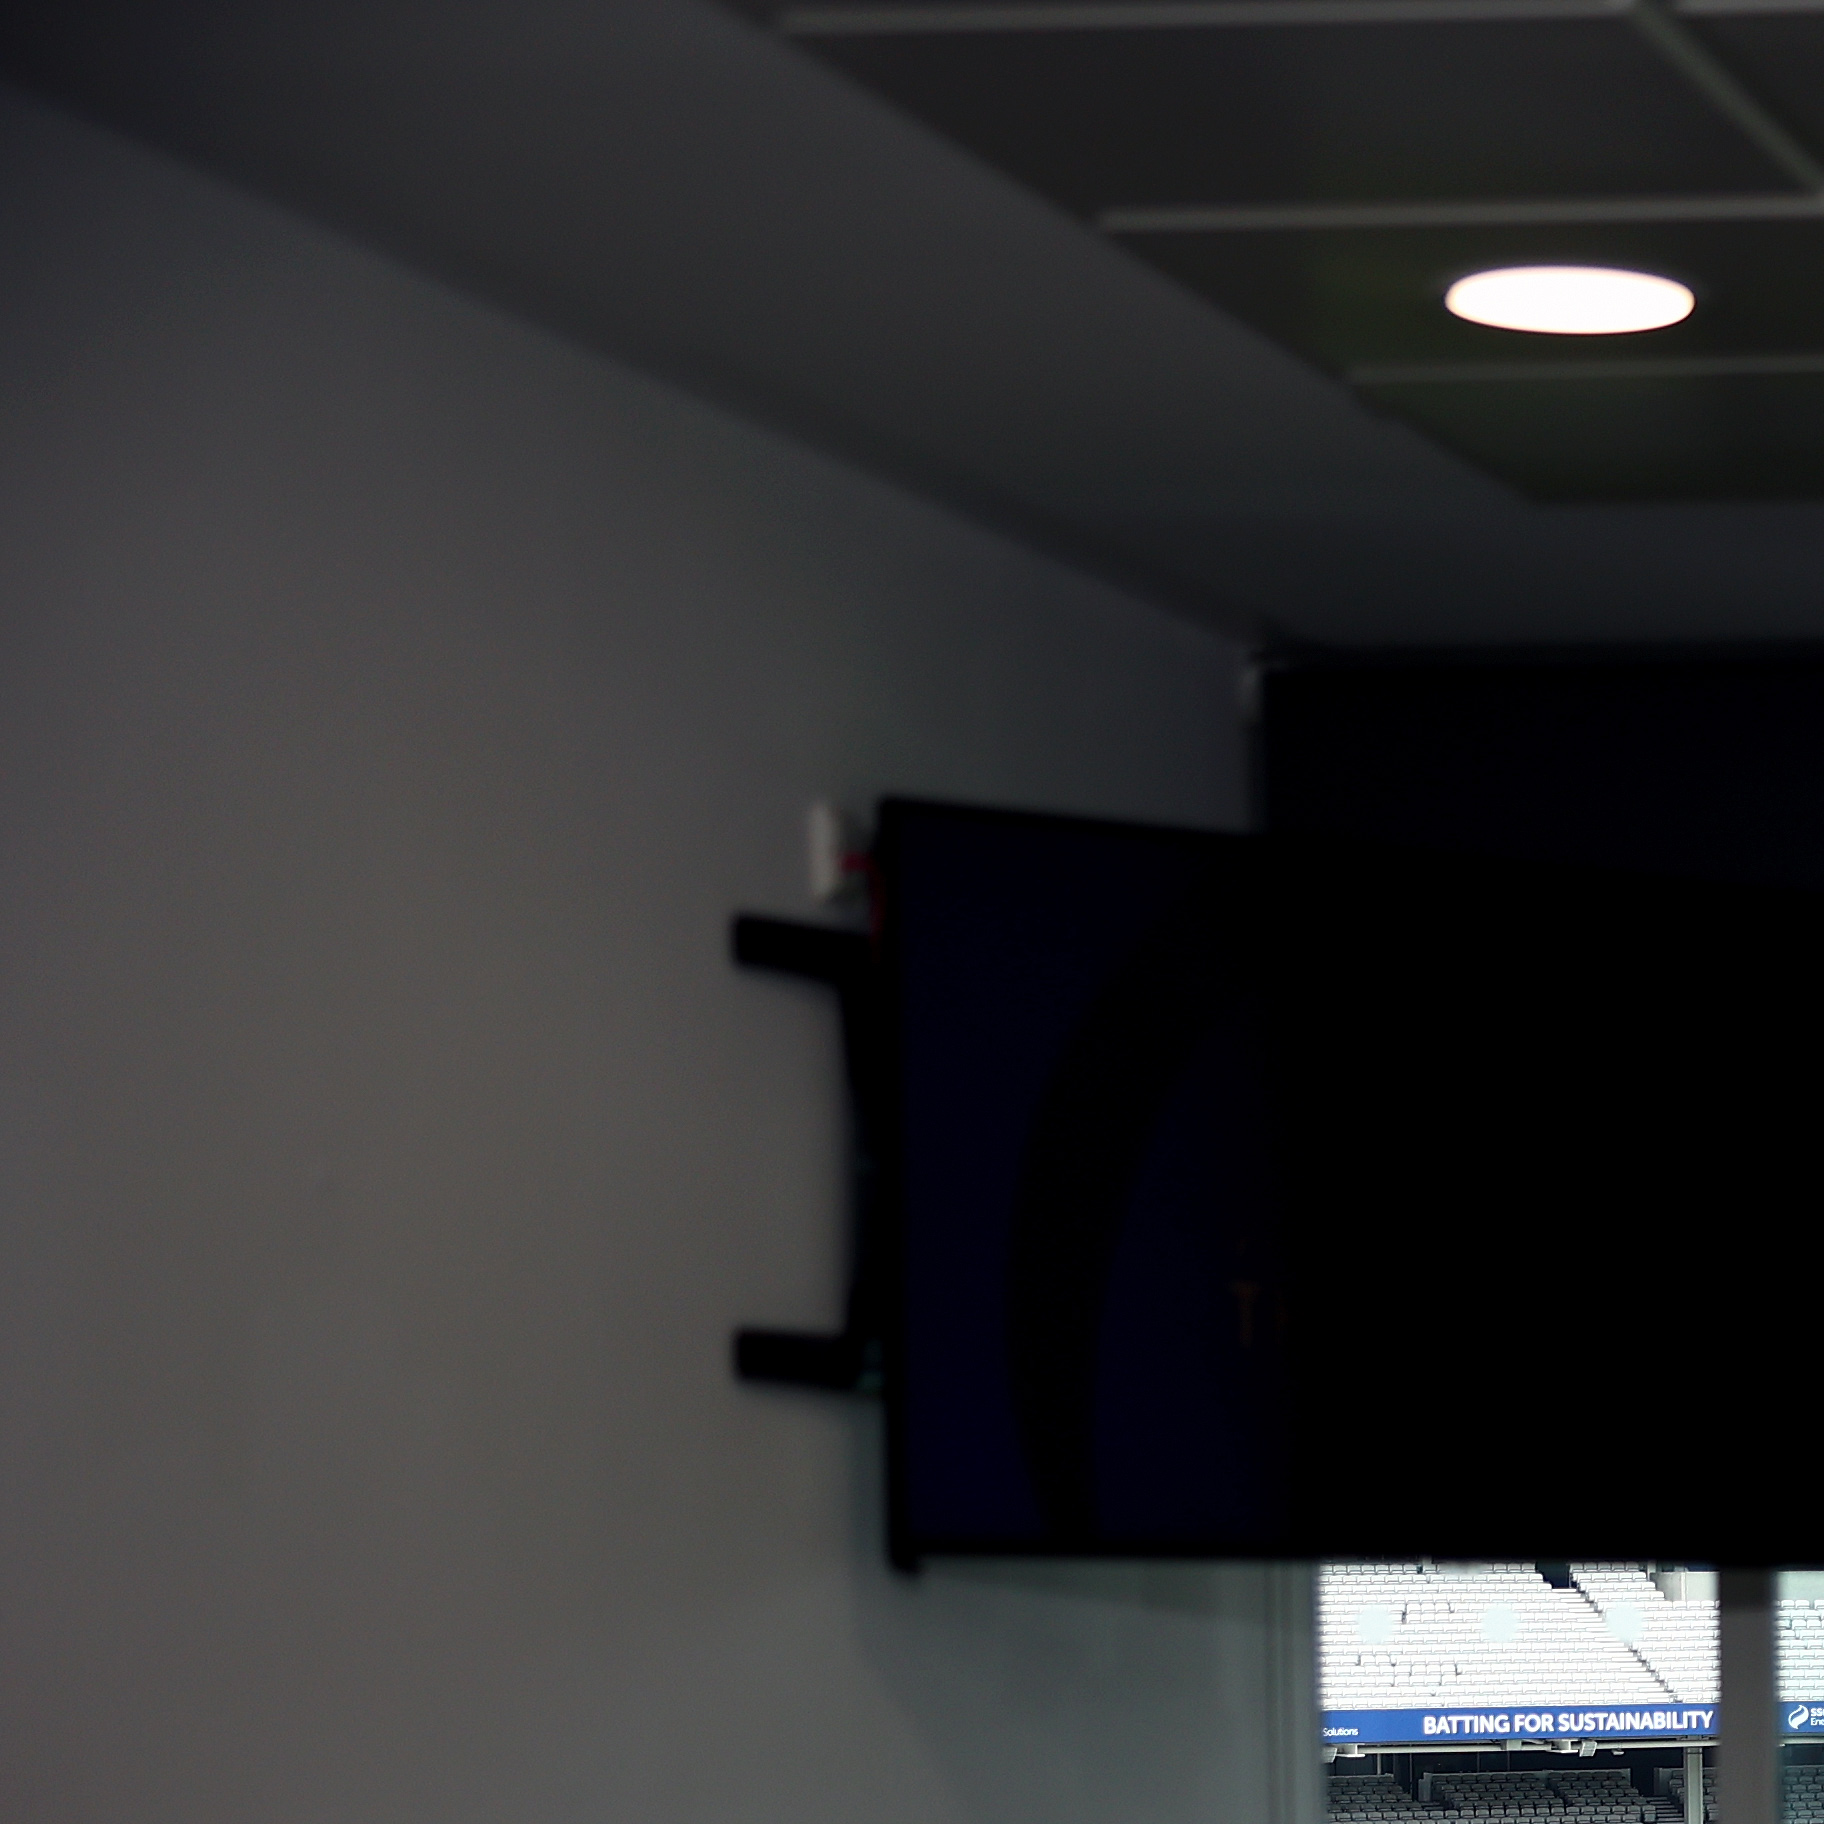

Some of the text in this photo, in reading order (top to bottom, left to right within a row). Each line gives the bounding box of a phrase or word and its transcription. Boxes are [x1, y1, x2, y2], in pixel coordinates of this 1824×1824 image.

[1423, 1710, 1714, 1736] BATTING FOR SUSTAINABILITY
